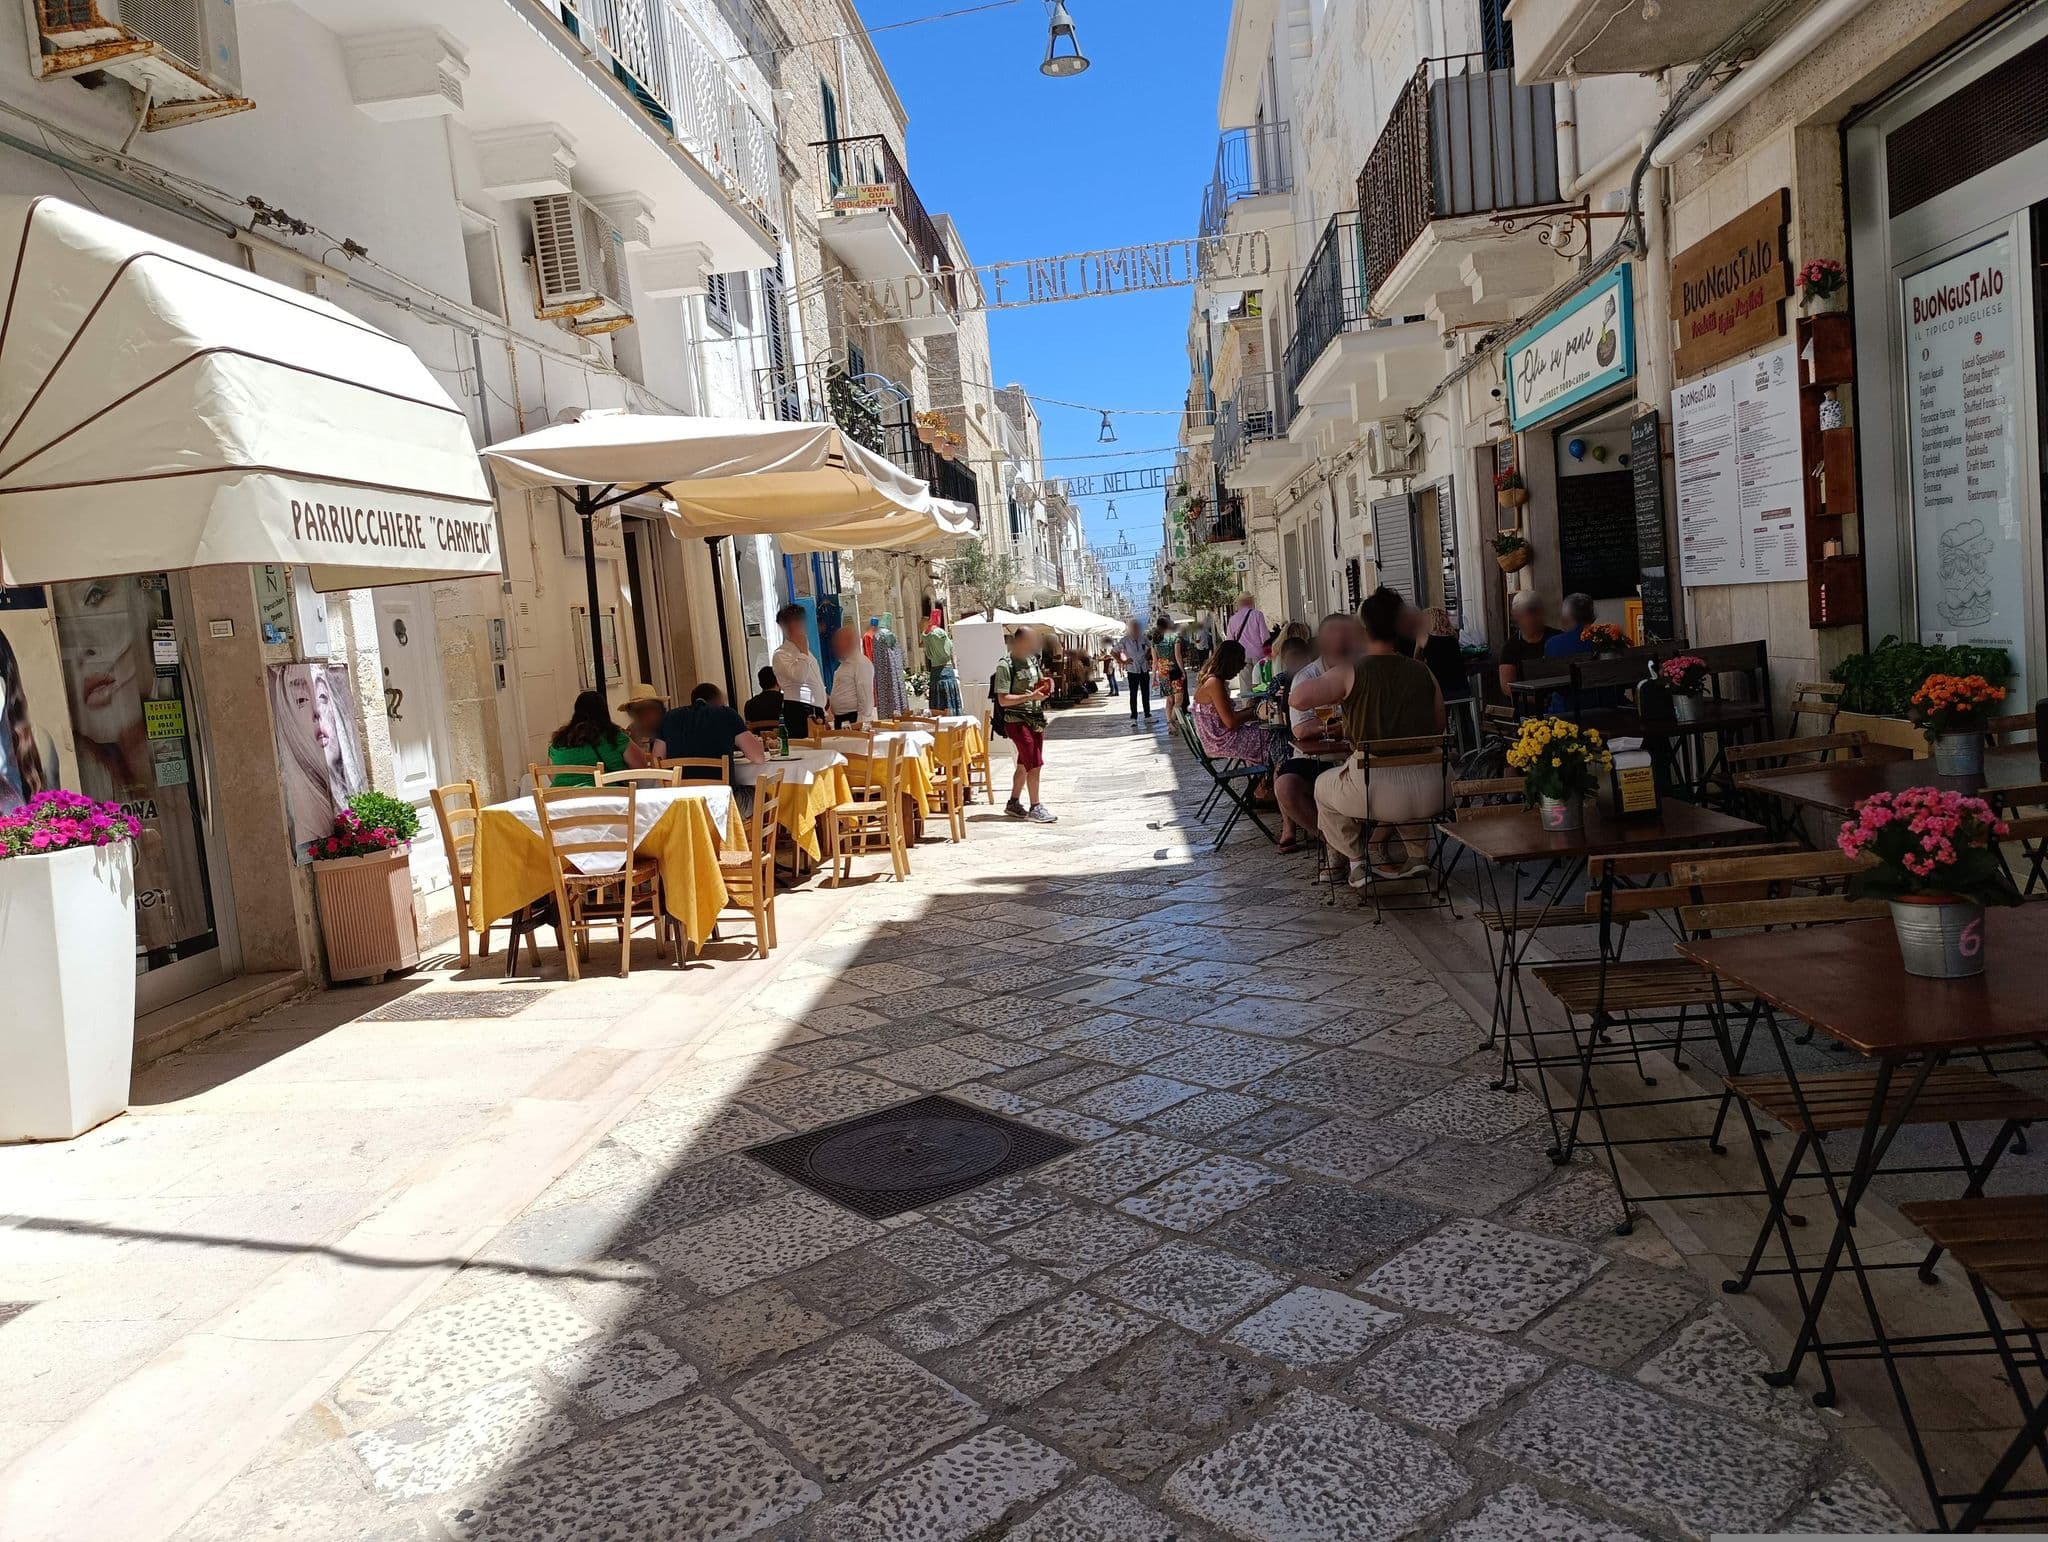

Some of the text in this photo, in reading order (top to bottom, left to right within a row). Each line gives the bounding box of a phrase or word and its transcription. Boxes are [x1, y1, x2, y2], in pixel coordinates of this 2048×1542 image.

[1912, 267, 2004, 325] BUONGUSTAIO
[1914, 302, 2003, 342] IL TIPICO PUGLIESE
[1961, 355, 1975, 370] Local
[1963, 384, 1993, 399] Sandwiches
[1965, 415, 1991, 430] Appetizers
[1965, 443, 1989, 457] Cocktails
[1966, 458, 1996, 472] Craft beers
[1103, 471, 1132, 494] NEL
[1140, 465, 1184, 489] CIELO
[1967, 475, 1980, 486] Wine
[1967, 489, 1998, 501] Gastronomy
[291, 499, 426, 550] PARRUCCHIERE
[1172, 508, 1186, 558] BAR
[161, 761, 182, 773] SOLO
[1550, 805, 1568, 826] 5
[1958, 917, 1981, 957] 6
